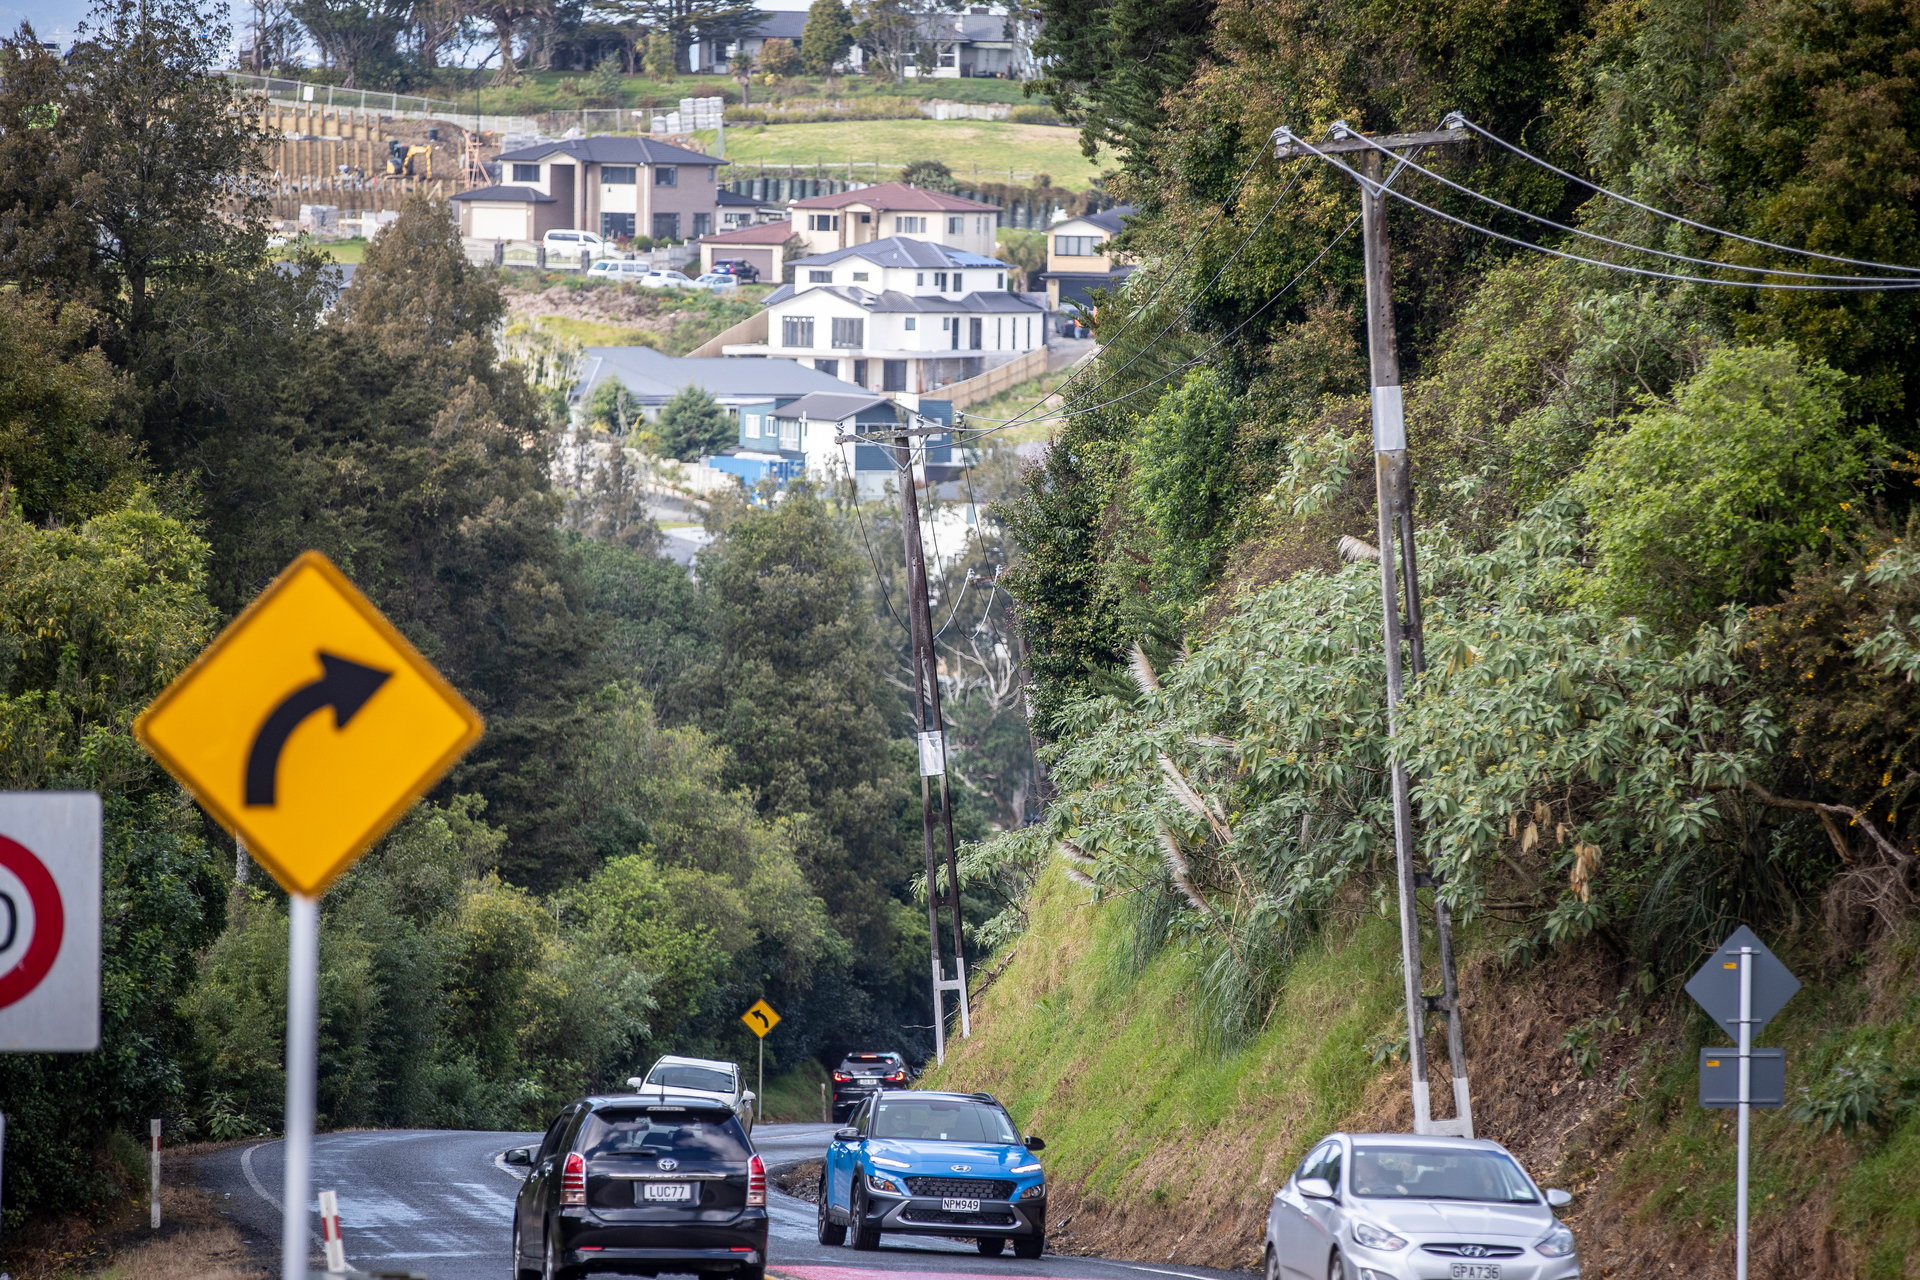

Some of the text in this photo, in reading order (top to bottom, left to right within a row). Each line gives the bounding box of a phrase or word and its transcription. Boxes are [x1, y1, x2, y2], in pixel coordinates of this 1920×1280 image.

[649, 1186, 685, 1198] LUC77
[943, 1199, 979, 1210] NPM949
[1452, 1265, 1499, 1279] GPA736
